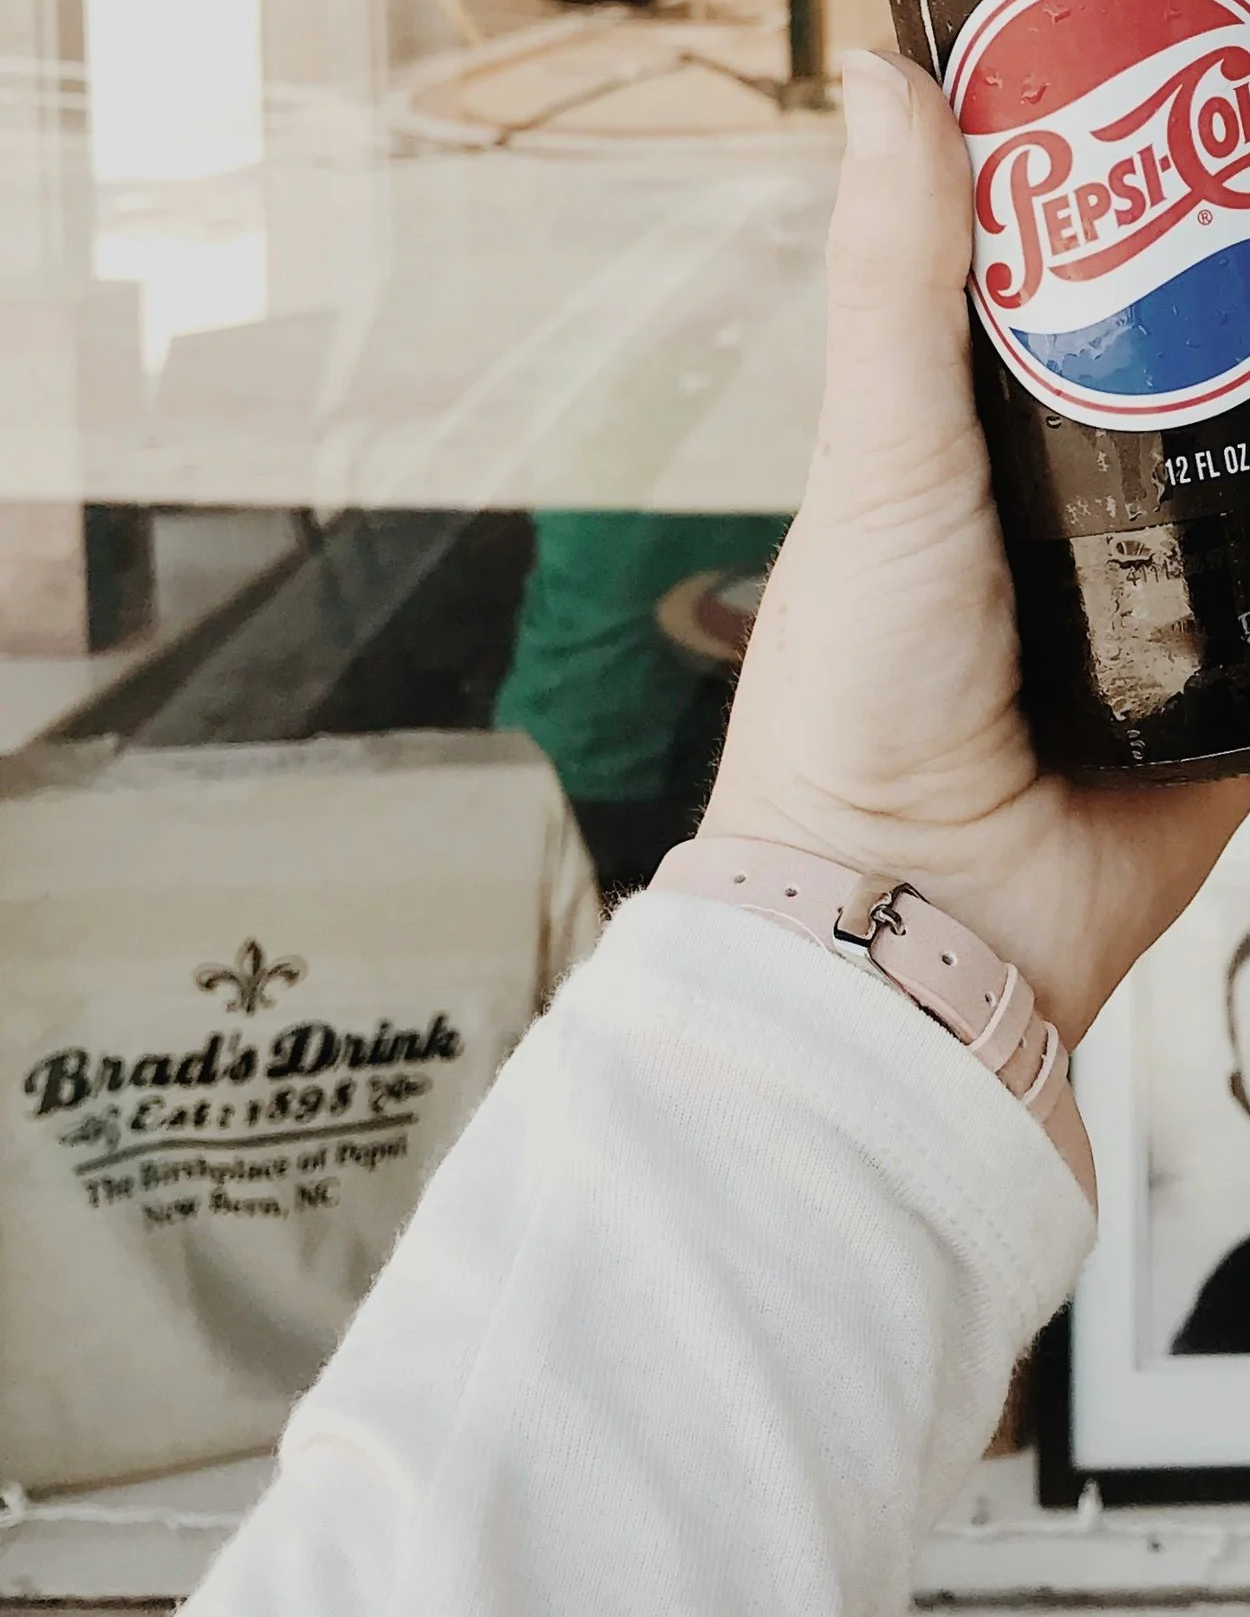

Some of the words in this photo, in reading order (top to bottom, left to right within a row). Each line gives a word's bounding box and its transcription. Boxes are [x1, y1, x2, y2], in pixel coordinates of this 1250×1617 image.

[1165, 455, 1191, 487] 12
[1195, 451, 1221, 482] FL
[1224, 443, 1250, 475] OZ
[22, 1030, 259, 1120] Brad's
[265, 1011, 464, 1078] Drink
